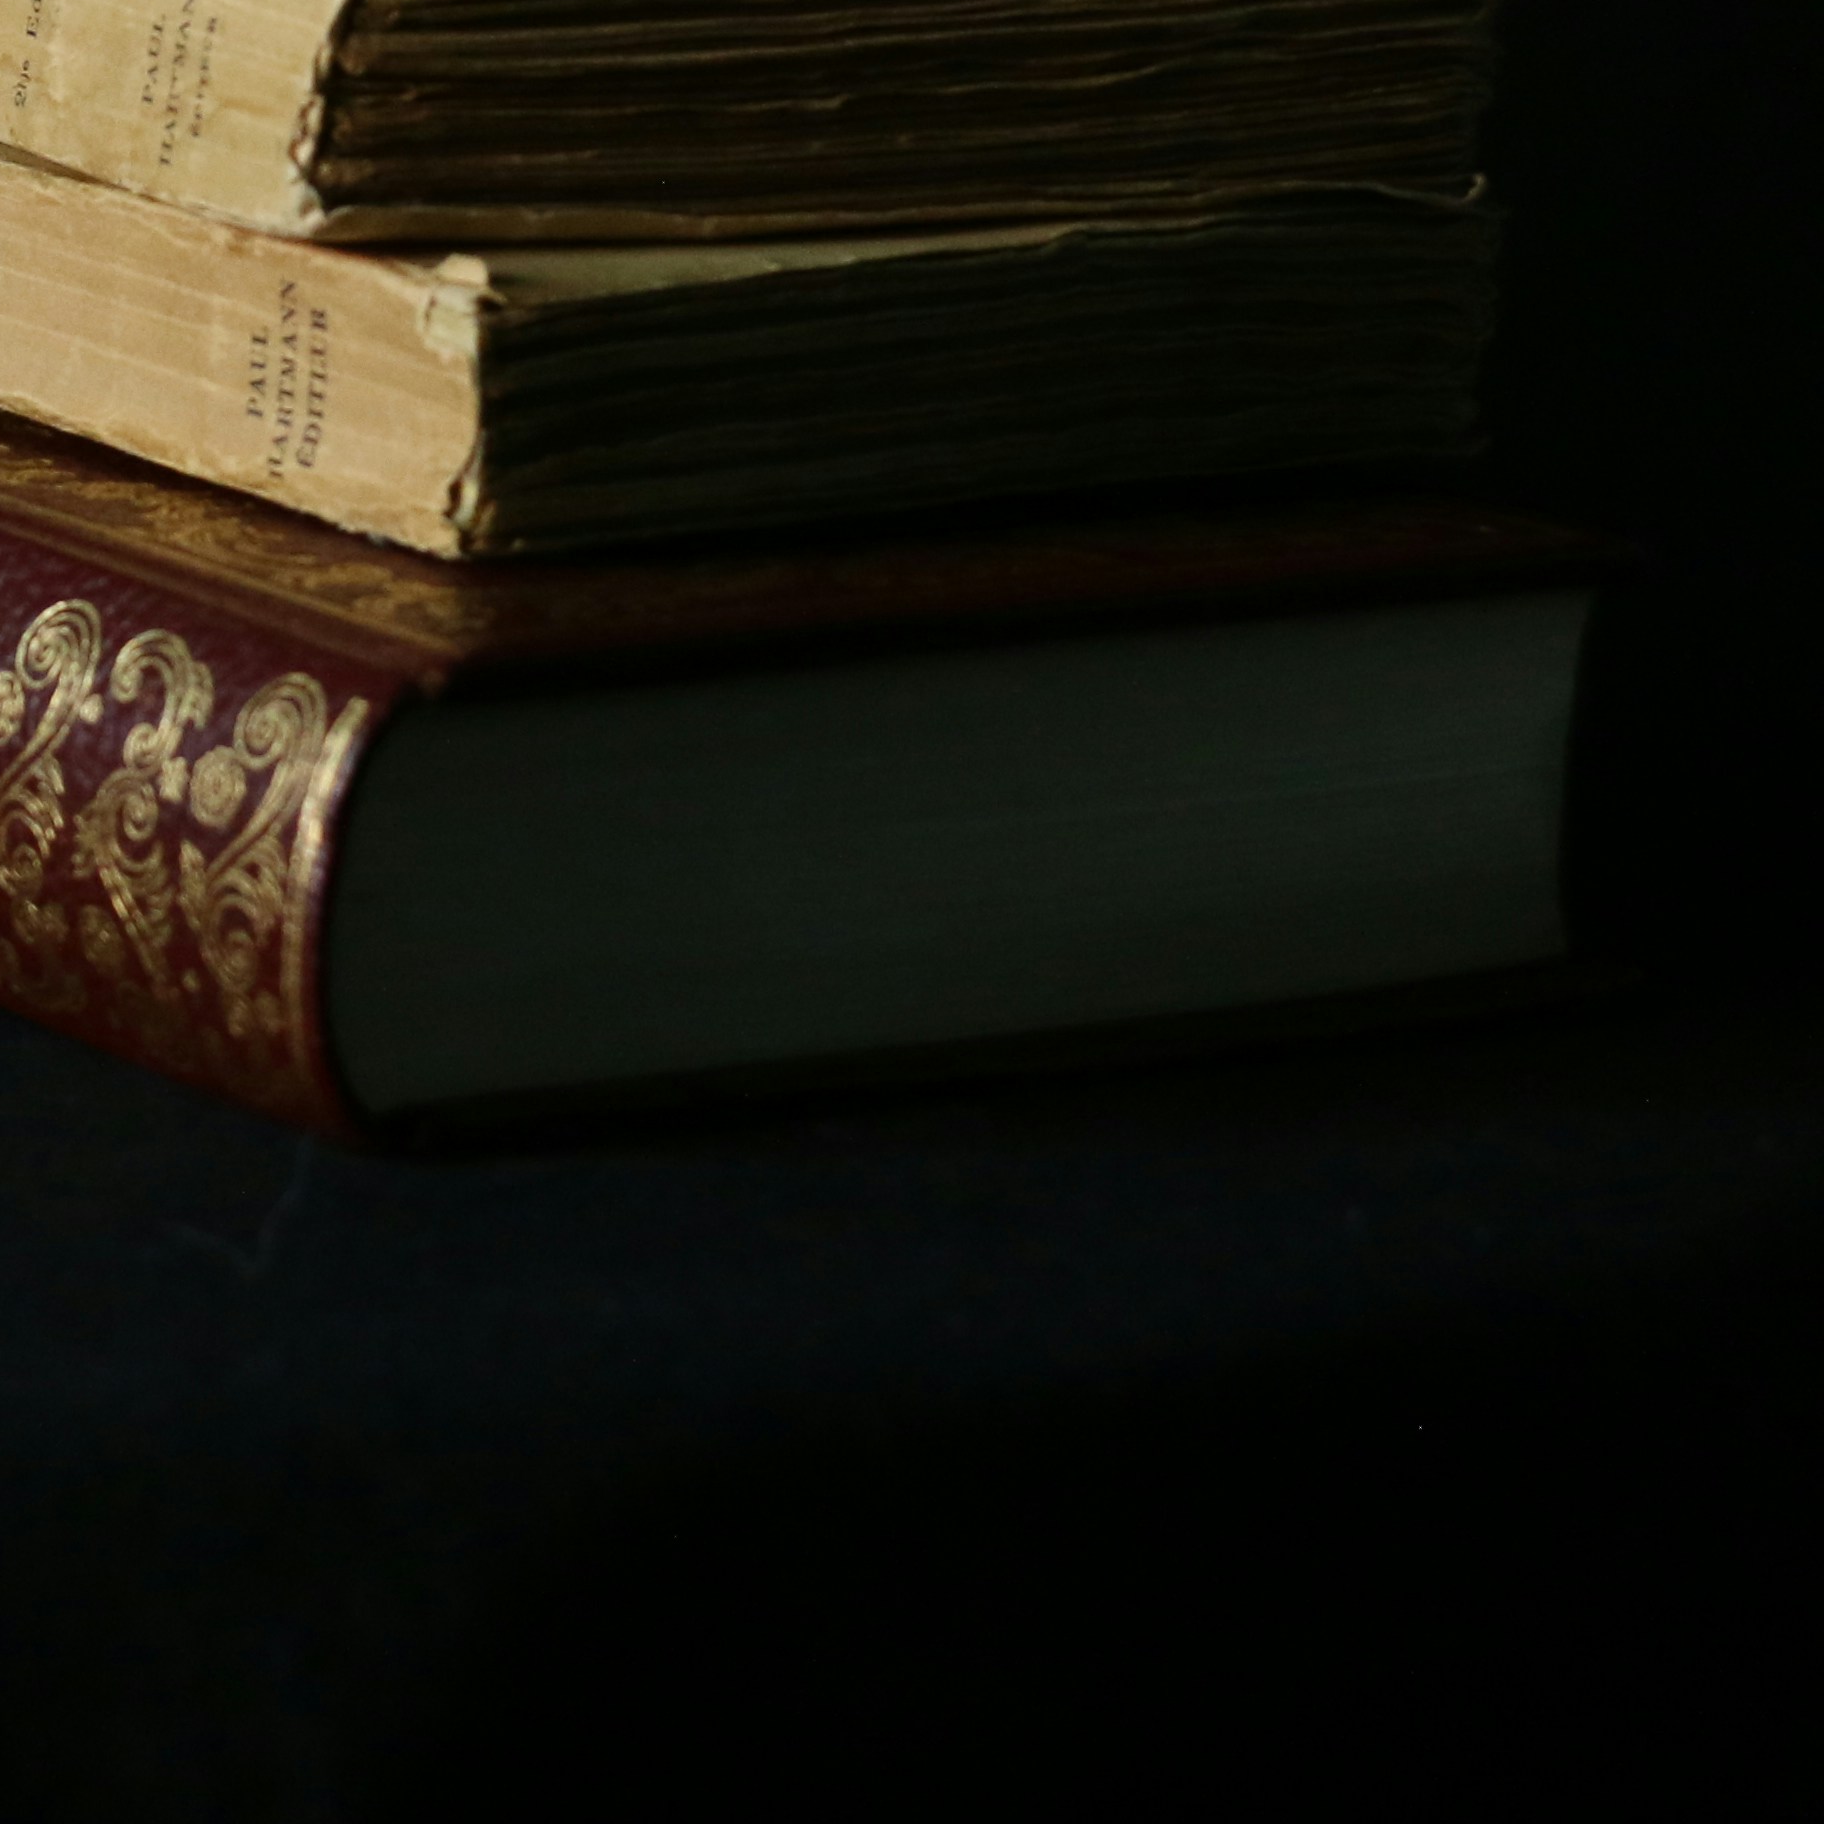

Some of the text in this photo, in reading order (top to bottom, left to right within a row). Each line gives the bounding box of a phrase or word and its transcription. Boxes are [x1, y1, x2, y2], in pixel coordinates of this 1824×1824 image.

[141, 14, 166, 105] PAUL
[247, 326, 268, 418] PAUL
[267, 277, 298, 479] HARTMANN
